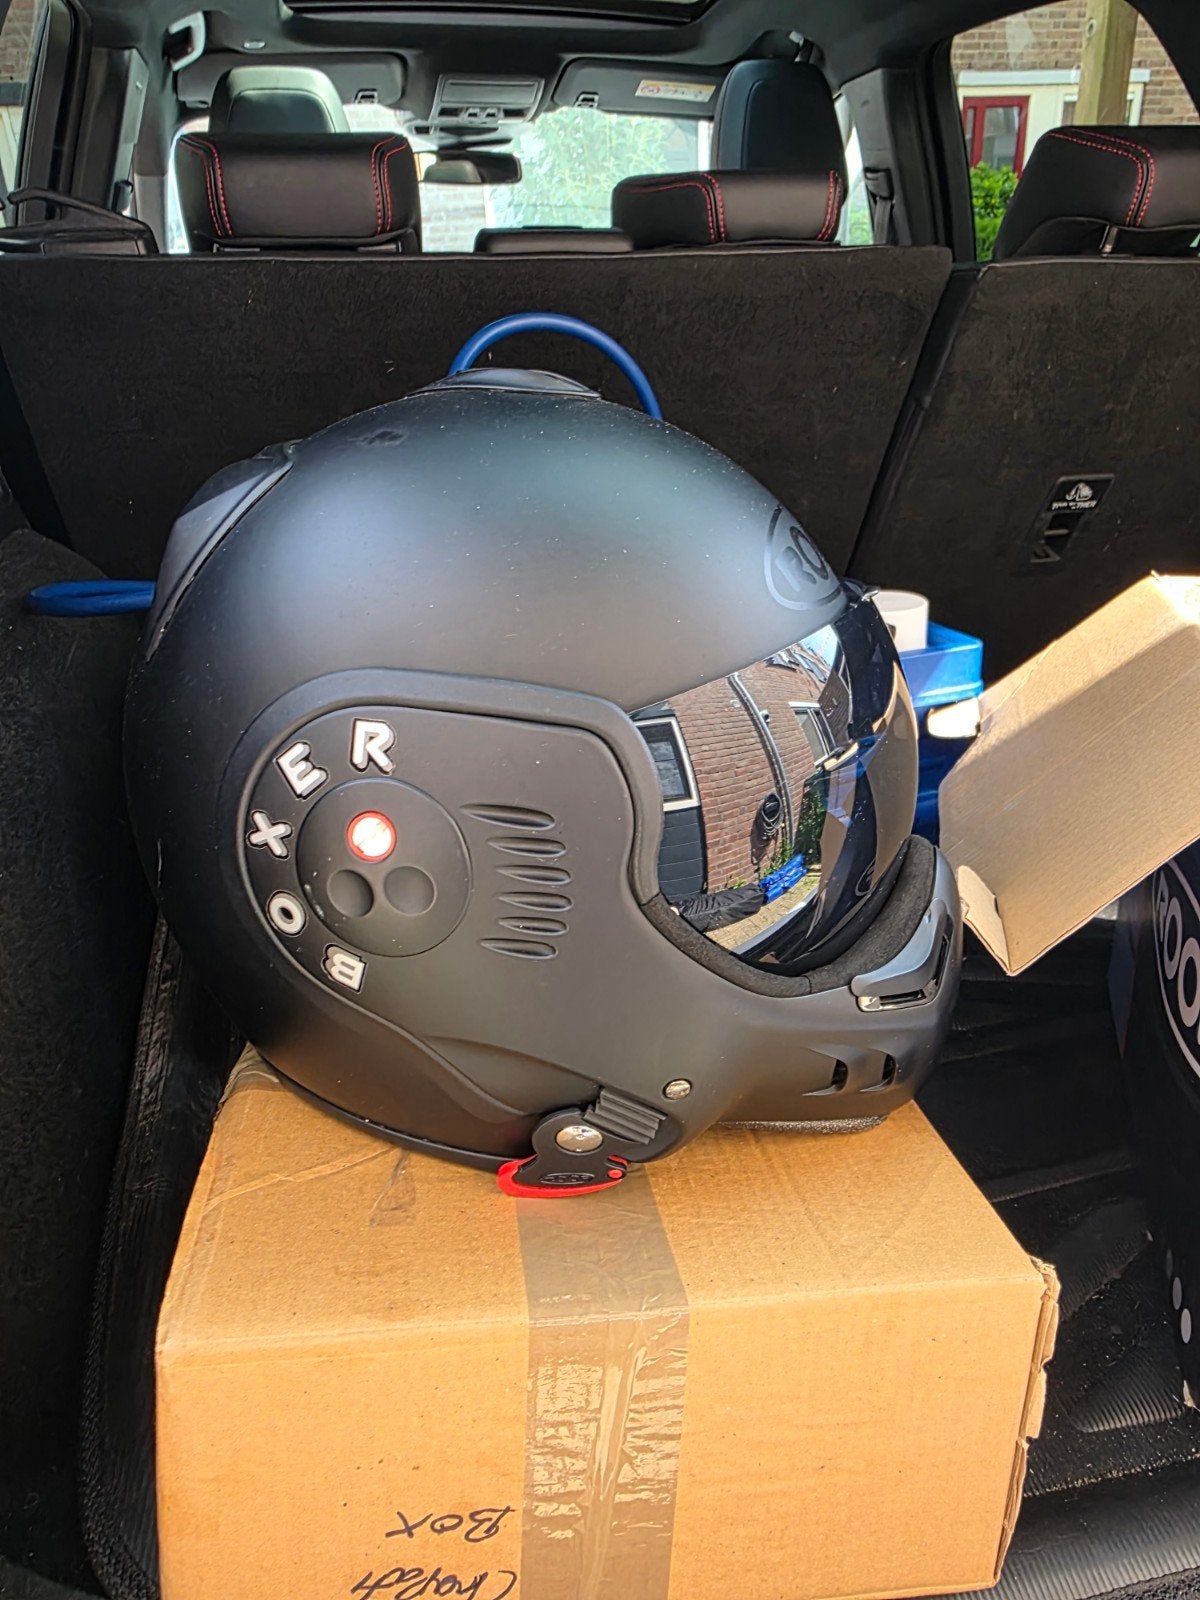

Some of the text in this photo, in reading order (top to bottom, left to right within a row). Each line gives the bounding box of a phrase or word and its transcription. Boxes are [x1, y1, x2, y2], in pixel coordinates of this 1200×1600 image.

[246, 717, 396, 994] BOXER
[1156, 869, 1200, 1046] ROO
[385, 1505, 516, 1543] BOX
